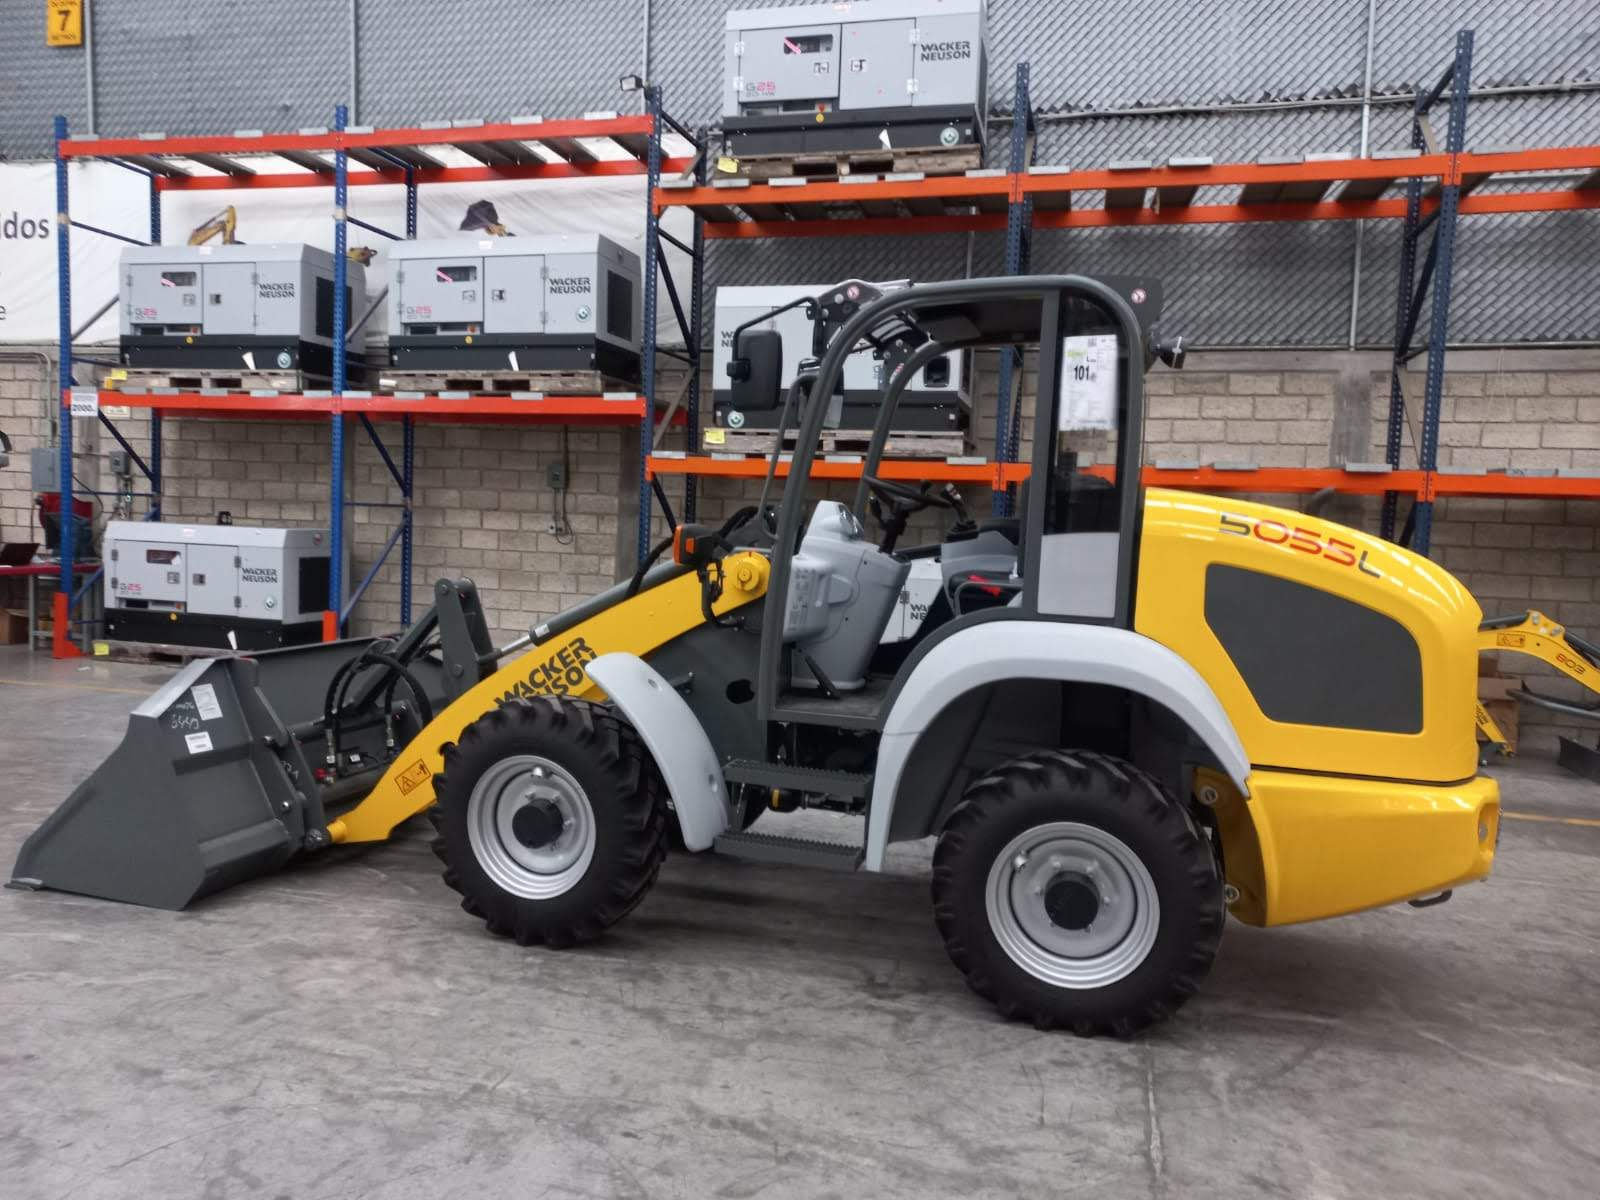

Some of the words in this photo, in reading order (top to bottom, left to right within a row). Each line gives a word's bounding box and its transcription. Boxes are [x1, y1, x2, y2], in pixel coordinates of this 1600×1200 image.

[57, 10, 71, 31] 7
[921, 41, 970, 51] WACKER
[921, 51, 970, 61] NEUSON
[0, 211, 49, 239] dos
[549, 277, 591, 286] WACKER
[259, 290, 295, 298] NEUSON
[550, 286, 591, 294] NEUSON
[1074, 365, 1090, 381] 101
[1219, 513, 1381, 579] 5055L
[494, 637, 598, 706] WACKER
